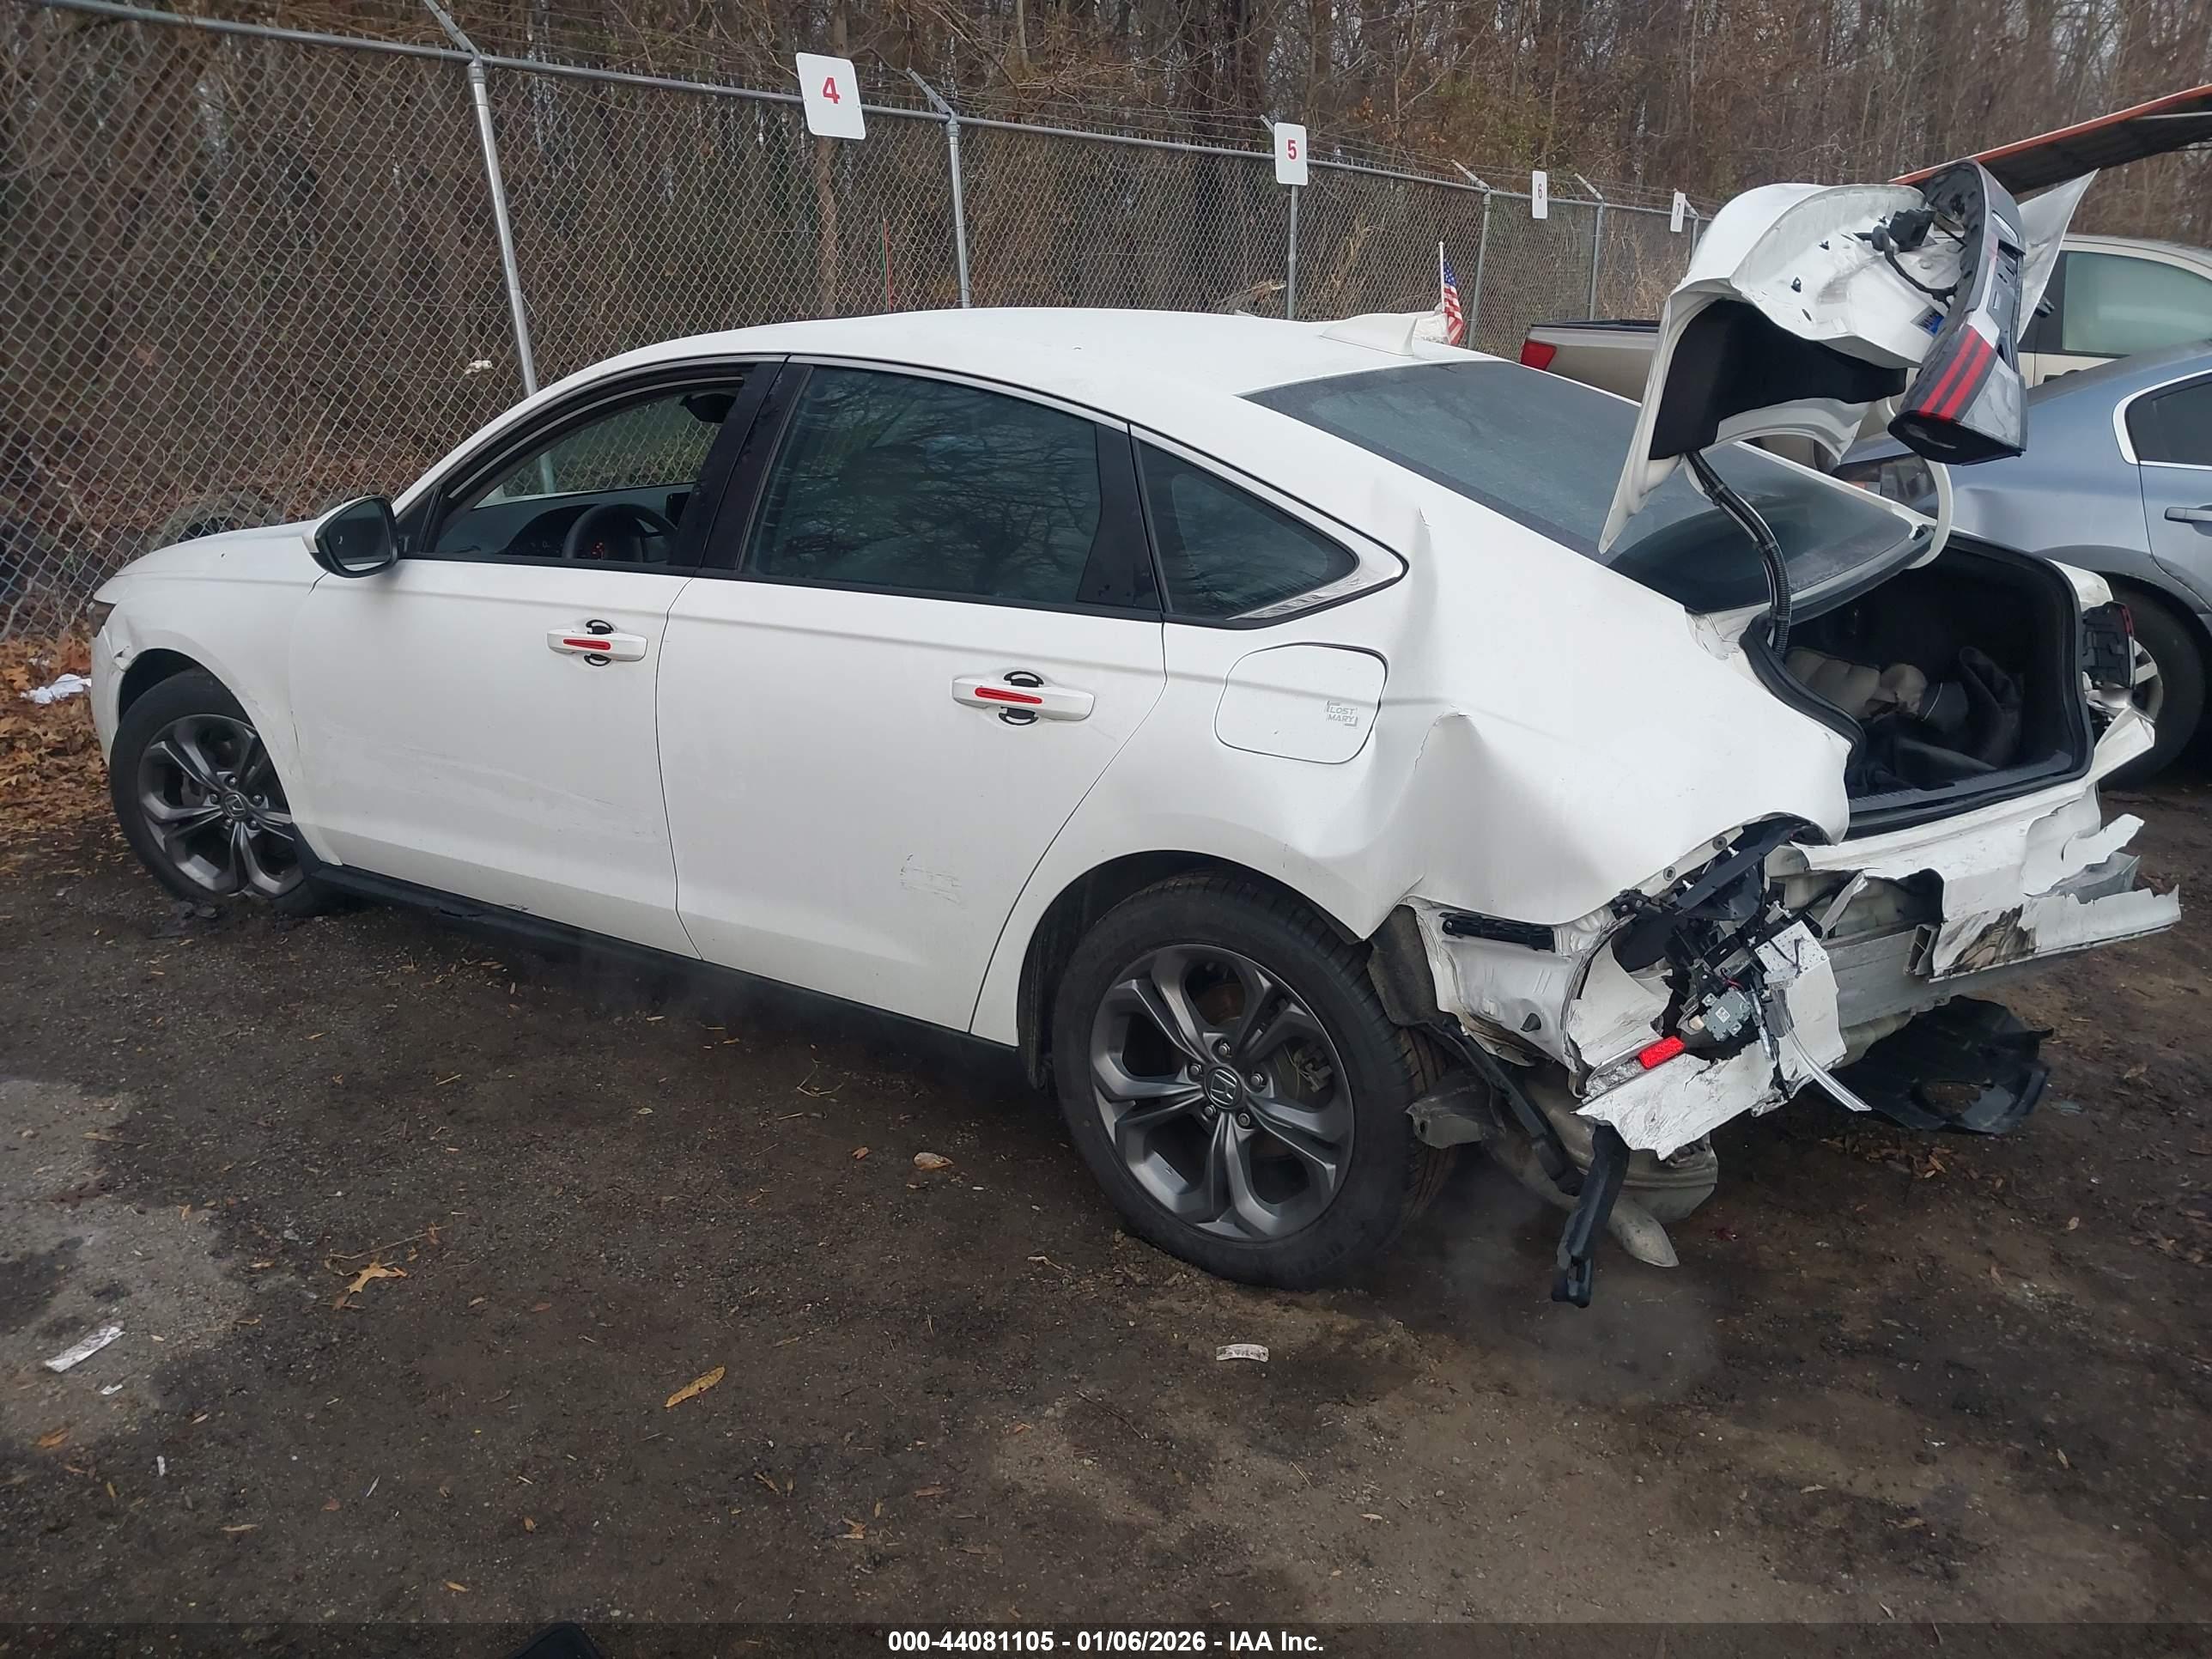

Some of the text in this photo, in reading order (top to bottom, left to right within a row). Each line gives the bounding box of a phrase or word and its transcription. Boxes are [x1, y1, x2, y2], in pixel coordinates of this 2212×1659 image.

[823, 76, 841, 105] 4
[1287, 138, 1297, 161] 5
[1537, 183, 1543, 200] 6
[1328, 714, 1354, 722] MARY
[1329, 706, 1355, 714] LOST
